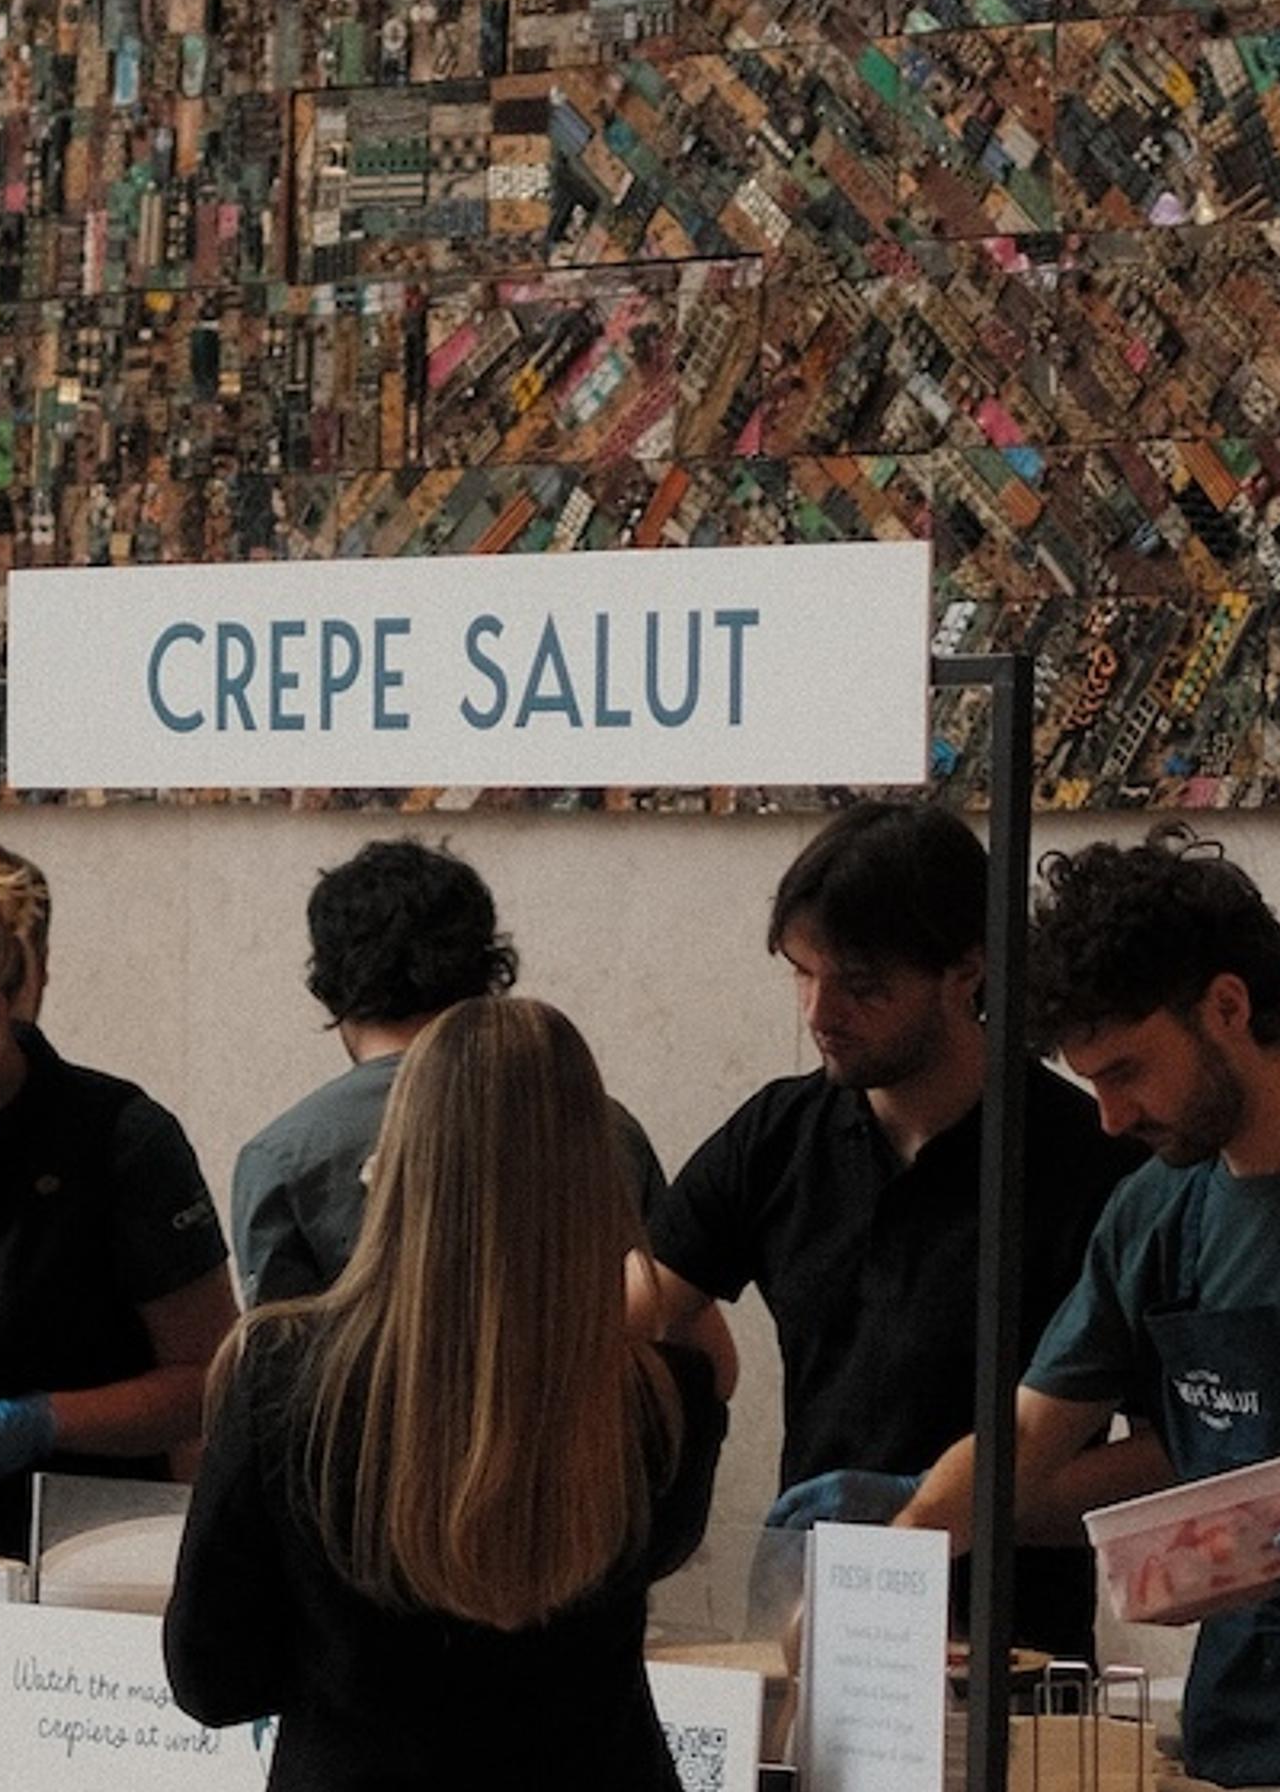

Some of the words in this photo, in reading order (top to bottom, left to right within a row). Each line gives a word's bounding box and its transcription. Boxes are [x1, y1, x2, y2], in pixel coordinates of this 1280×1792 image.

[147, 617, 411, 734] CREPE
[460, 609, 760, 730] SALUT
[13, 1656, 83, 1696] Watch
[88, 1674, 120, 1701] the
[128, 1684, 168, 1710] mag
[38, 1717, 130, 1759] crepiers
[135, 1725, 160, 1749] at
